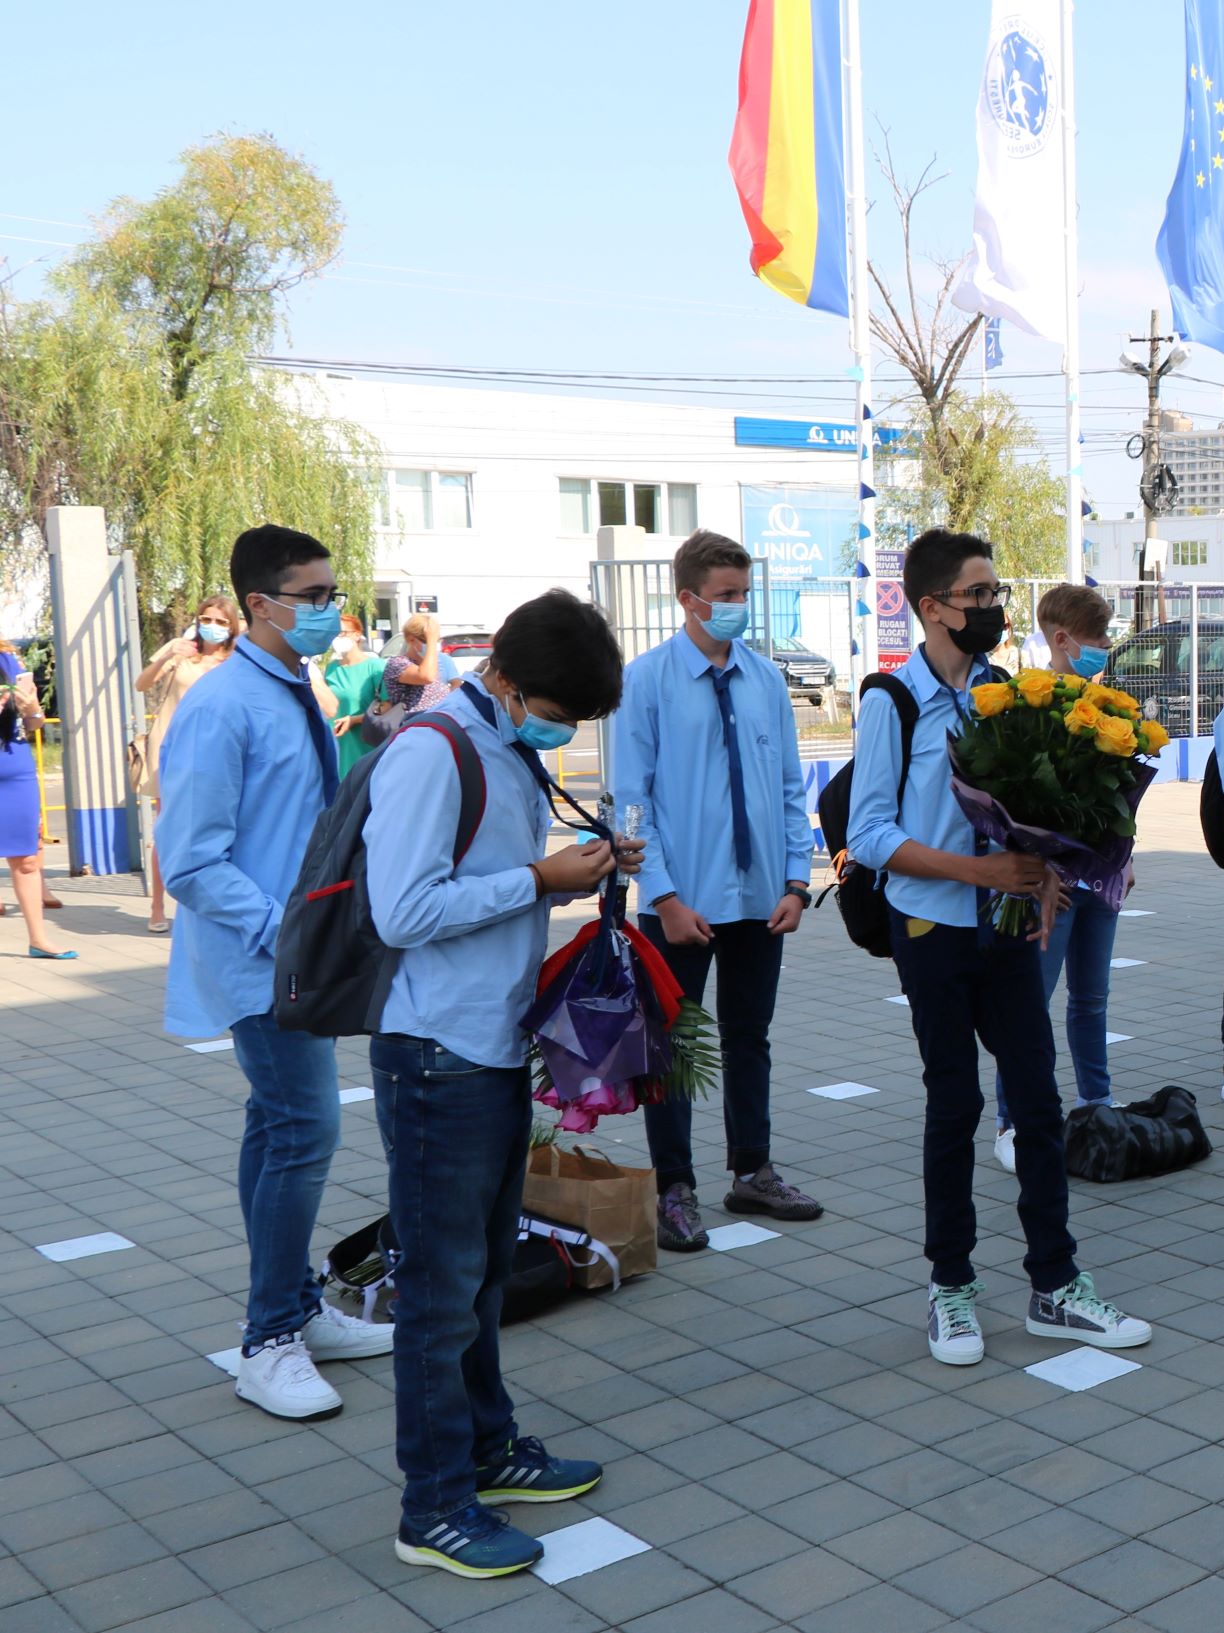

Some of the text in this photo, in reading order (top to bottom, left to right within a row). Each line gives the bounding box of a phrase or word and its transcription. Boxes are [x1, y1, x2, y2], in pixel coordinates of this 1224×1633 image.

[833, 429, 882, 446] UNA
[753, 542, 823, 561] UNIQA
[877, 637, 904, 645] CCESUL
